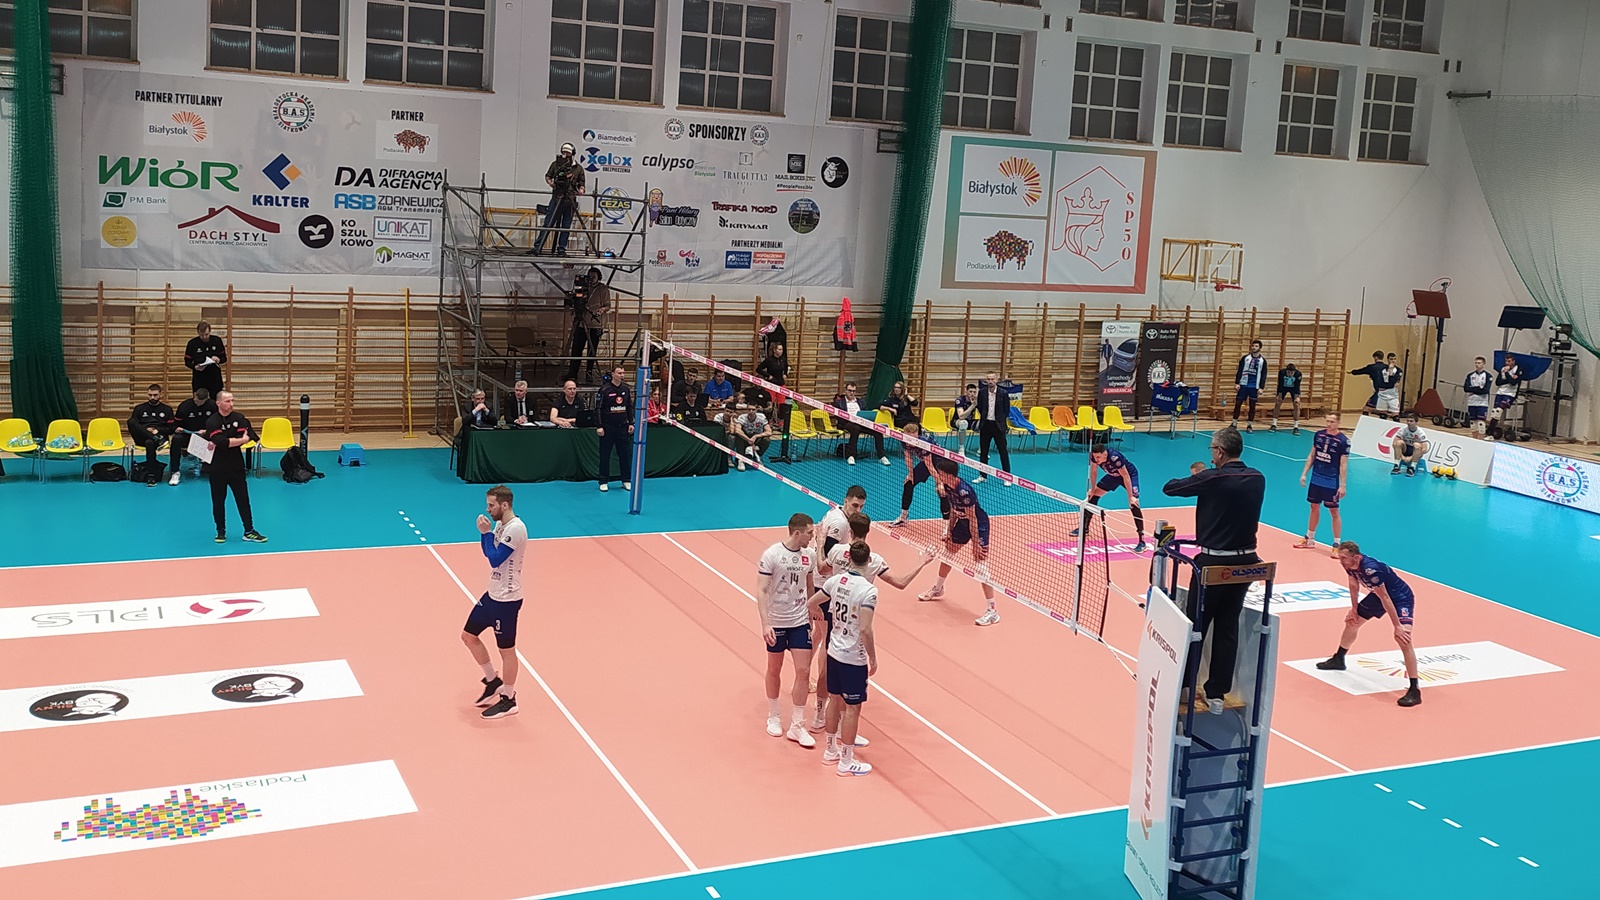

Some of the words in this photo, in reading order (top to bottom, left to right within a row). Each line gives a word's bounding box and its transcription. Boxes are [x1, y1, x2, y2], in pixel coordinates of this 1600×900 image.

[135, 90, 173, 104] PARTNER
[175, 93, 223, 107] TYTULARNY
[391, 110, 424, 122] PARTNER
[148, 125, 189, 136] Białystok
[689, 123, 747, 141] SPONSORZY
[597, 133, 634, 143] Biameditek
[642, 153, 695, 171] calypso
[334, 166, 376, 187] DA
[379, 168, 443, 181] DIFRAGMA
[378, 178, 442, 191] AGENCY
[968, 180, 1018, 197] Białystok
[146, 196, 167, 204] Bank
[252, 194, 310, 208] KALTER
[334, 193, 376, 210] ASB
[378, 195, 444, 208] ZDANEWICZ
[599, 200, 631, 208] CEZAS
[396, 206, 442, 214] Transmissio
[341, 219, 356, 227] KO
[189, 230, 228, 240] DACH
[233, 232, 268, 242] STYL
[340, 229, 368, 237] SZUL
[340, 238, 374, 247] KOWO
[731, 239, 760, 248] PARTNERZY
[760, 240, 783, 249] MEDIALNI
[966, 261, 997, 270] Podlaskie
[790, 572, 799, 586] 14
[835, 601, 848, 623] 22
[1152, 628, 1178, 665] KRISPOL
[1143, 670, 1161, 812] KRISPOL
[199, 773, 308, 795] Podlaskie
